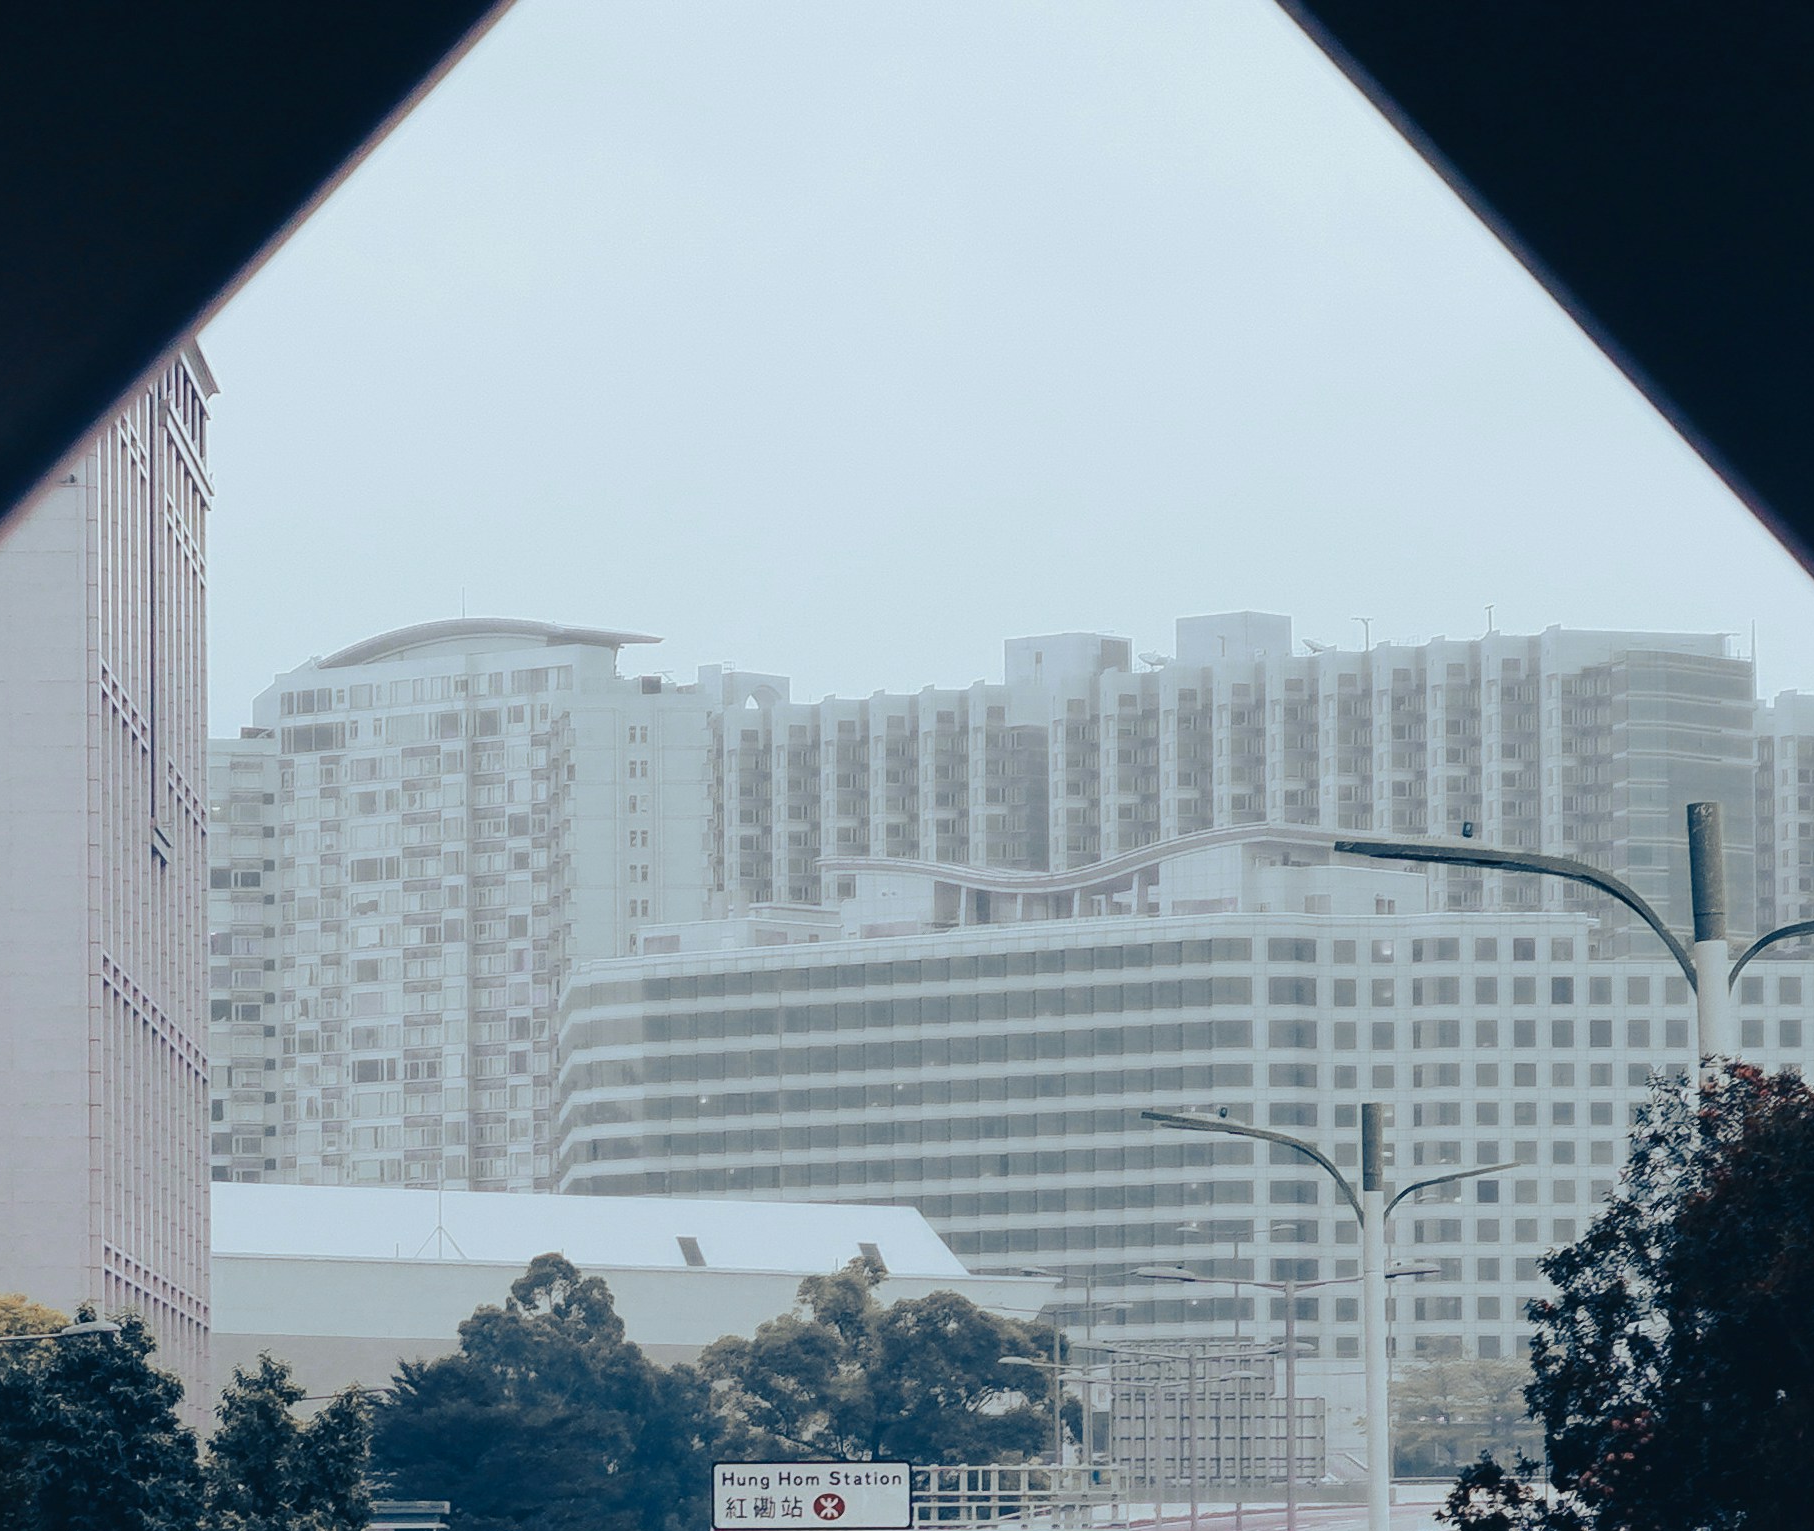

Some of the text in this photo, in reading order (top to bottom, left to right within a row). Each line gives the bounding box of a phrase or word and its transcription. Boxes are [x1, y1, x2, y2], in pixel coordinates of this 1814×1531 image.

[721, 1471, 902, 1489] Hung Hom Station
[725, 1496, 803, 1519] 紅磡站
